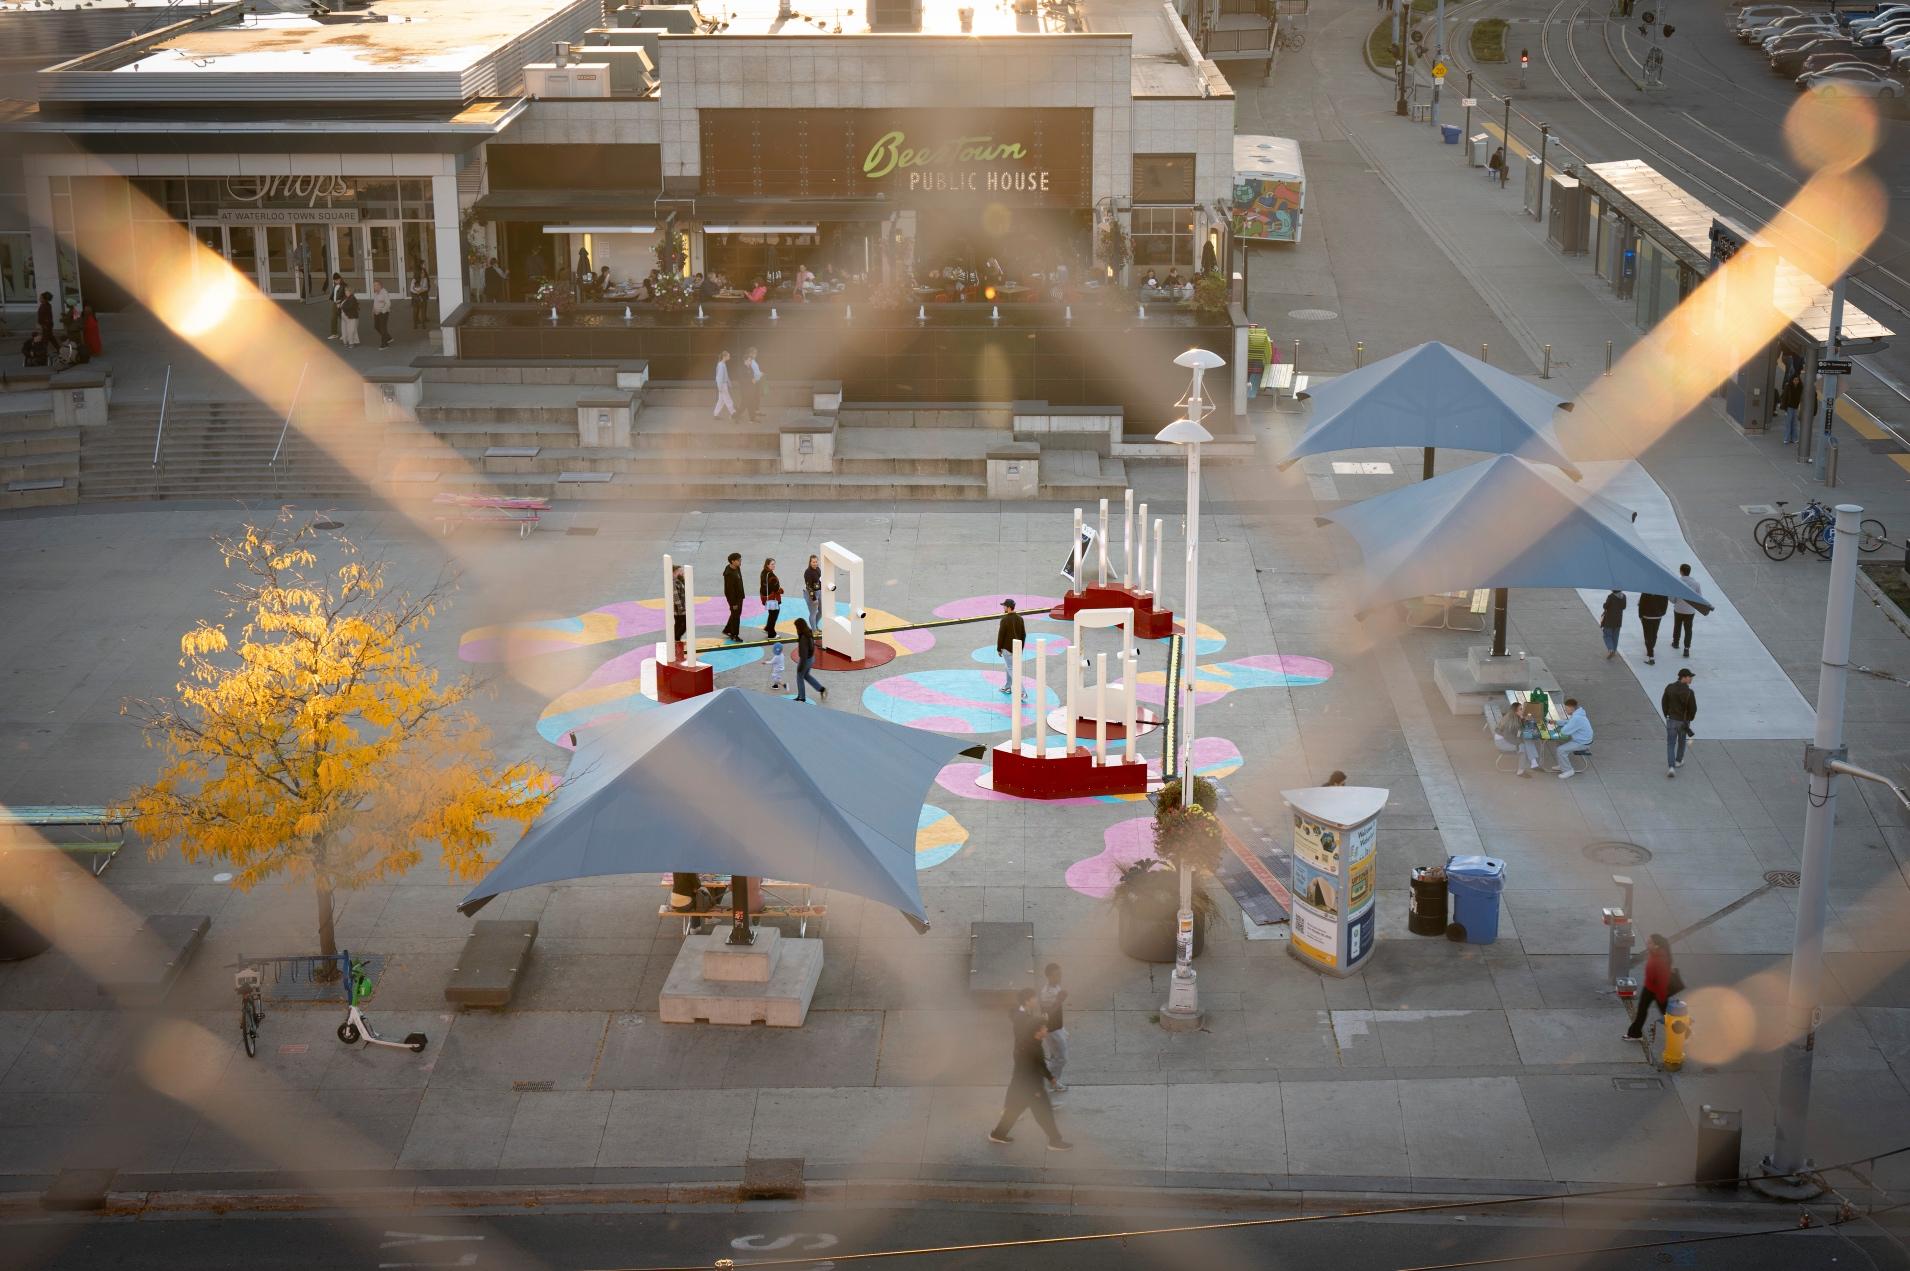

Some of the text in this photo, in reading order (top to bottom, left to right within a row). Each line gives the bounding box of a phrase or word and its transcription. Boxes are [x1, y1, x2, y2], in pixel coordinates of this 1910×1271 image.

[910, 172, 1049, 190] PUBLIC HOUSE
[222, 212, 356, 220] AT WATERLOO TOWN SQUARE
